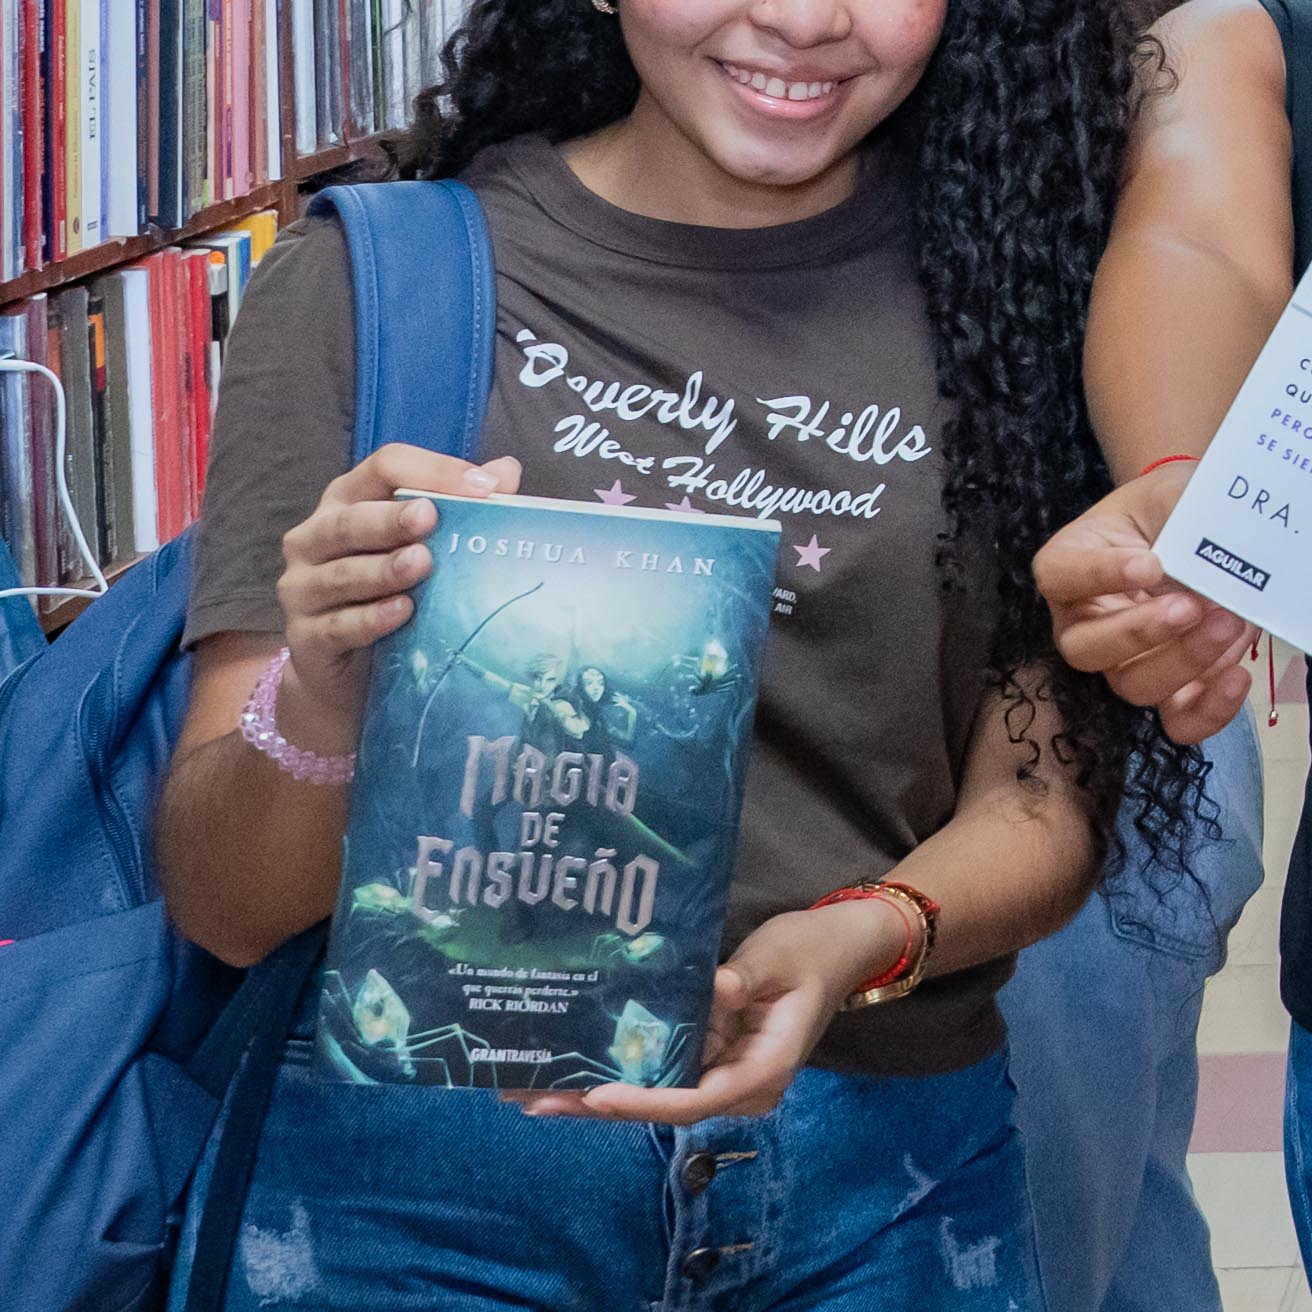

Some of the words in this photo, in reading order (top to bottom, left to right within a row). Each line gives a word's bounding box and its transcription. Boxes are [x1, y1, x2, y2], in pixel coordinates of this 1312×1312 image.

[756, 395, 932, 465] Hills
[1256, 433, 1278, 452] SE
[553, 414, 655, 474] West
[662, 456, 887, 520] Hollywood
[1227, 474, 1300, 535] DRA.
[449, 532, 588, 566] JOSHUA
[615, 550, 716, 577] KHAN
[1199, 543, 1268, 589] AGUILAR
[460, 734, 640, 818] MAGIA
[520, 811, 566, 849] DE
[411, 834, 660, 937] ENSUEÑO
[462, 984, 482, 997] que
[476, 967, 514, 979] mundo
[515, 968, 529, 979] de
[468, 997, 503, 1011] RICK
[505, 999, 569, 1013] RIORDAN
[470, 1048, 552, 1063] GRANTRAVESÍA
